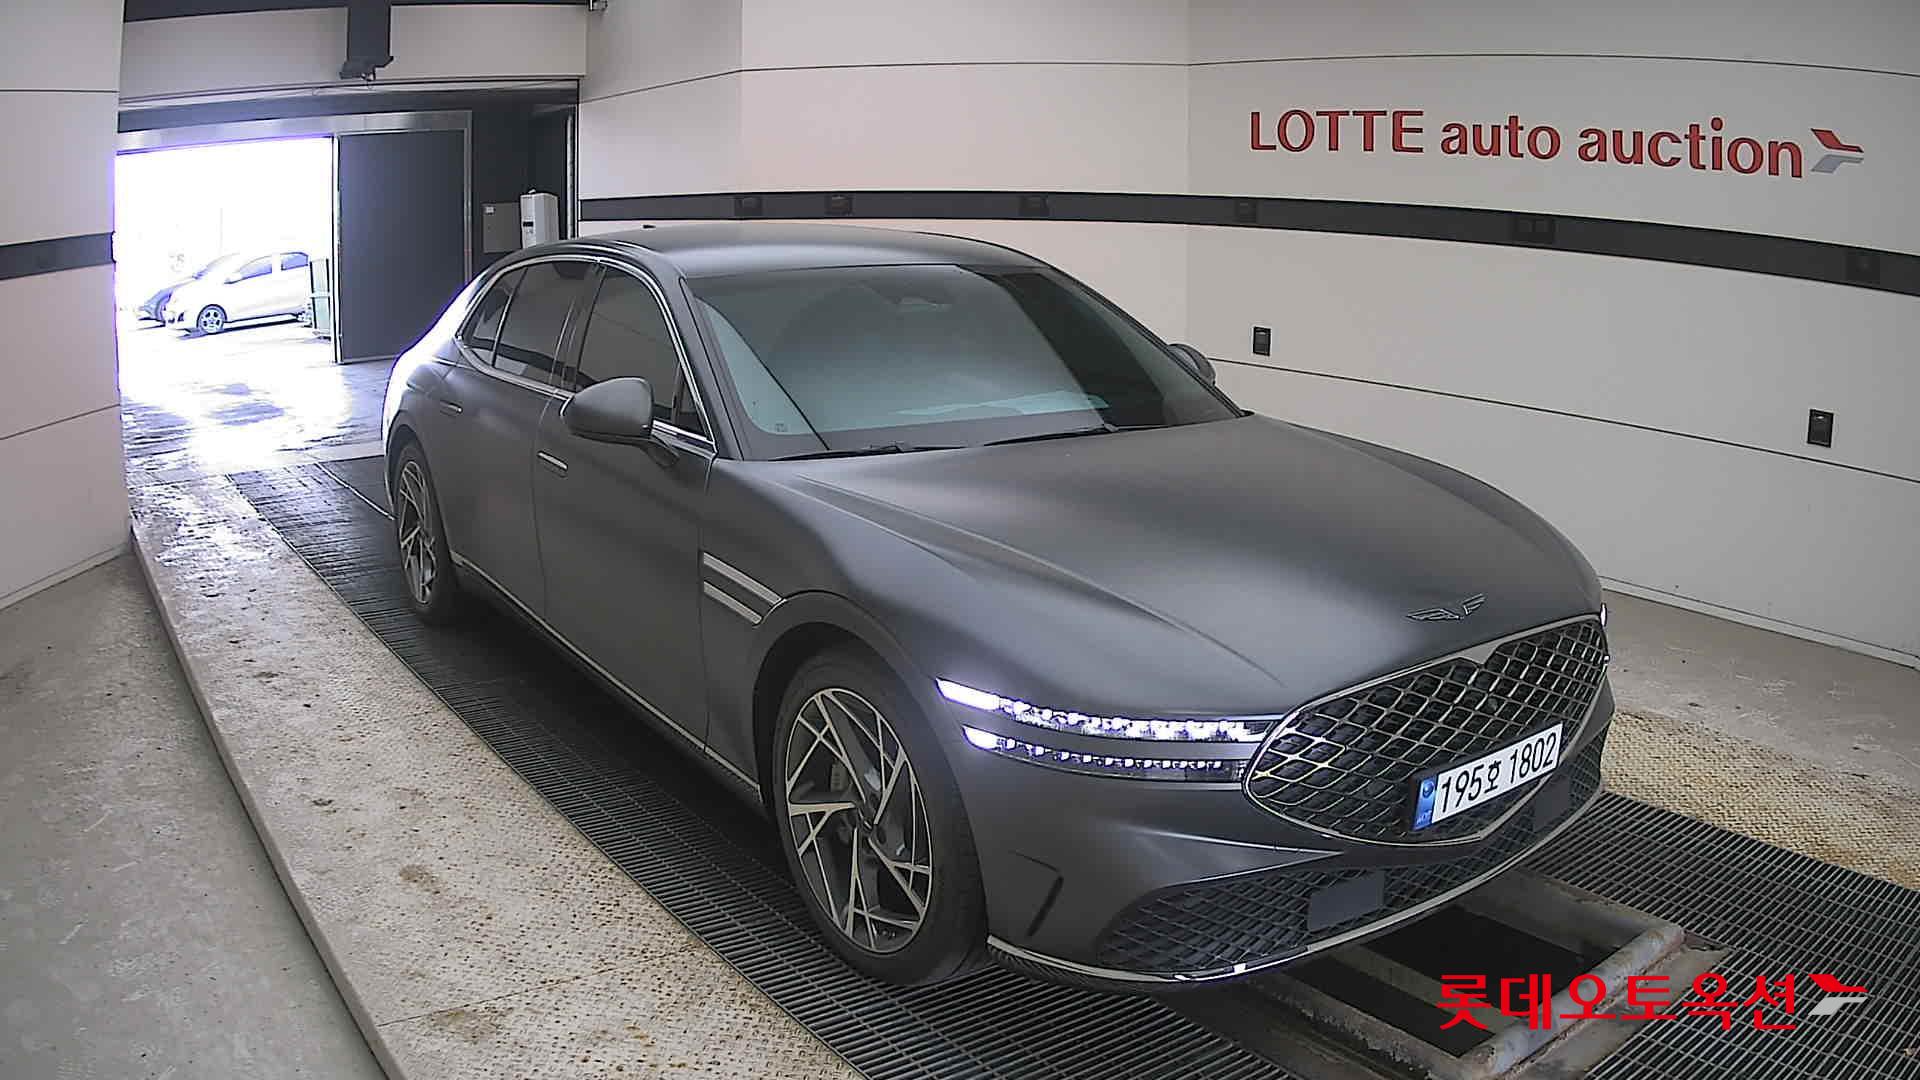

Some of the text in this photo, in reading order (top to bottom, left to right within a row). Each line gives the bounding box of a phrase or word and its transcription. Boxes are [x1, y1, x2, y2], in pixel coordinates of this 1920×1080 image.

[1250, 110, 1803, 178] LOTTE auto auction
[1441, 732, 1557, 813] 195호 1802
